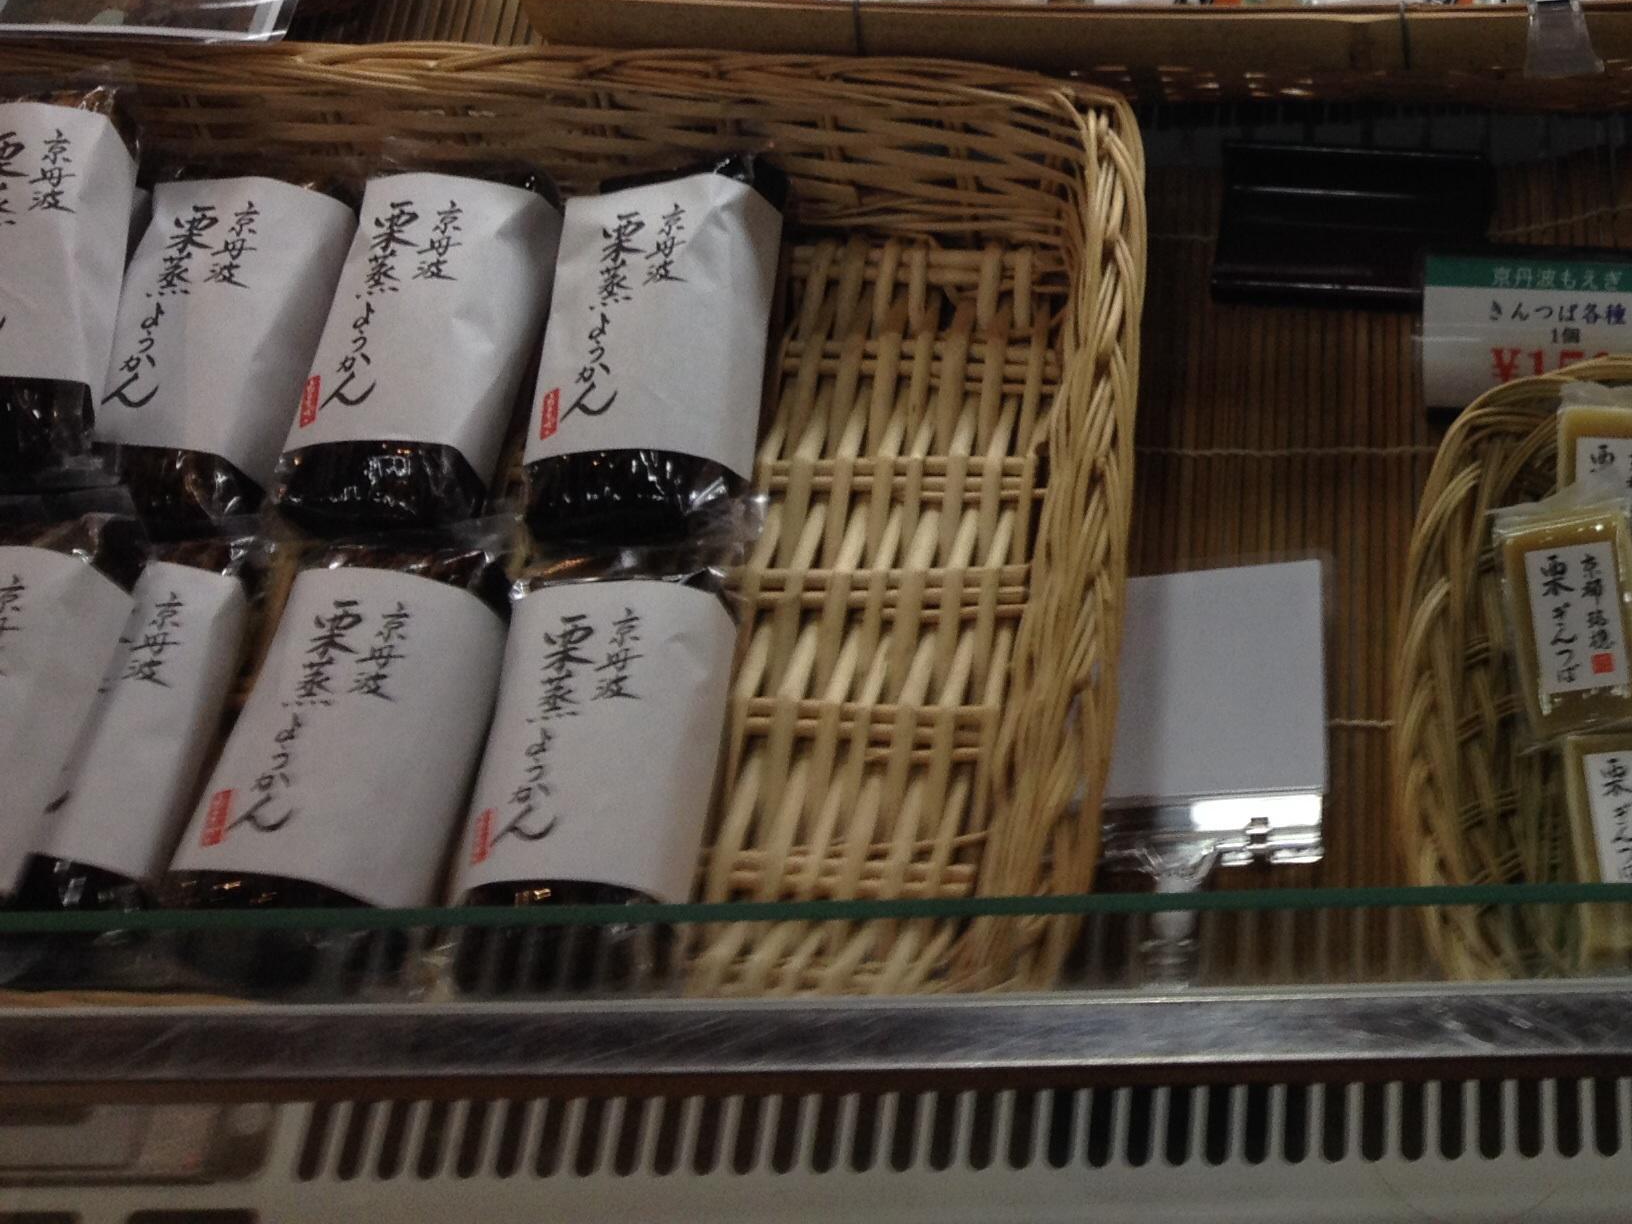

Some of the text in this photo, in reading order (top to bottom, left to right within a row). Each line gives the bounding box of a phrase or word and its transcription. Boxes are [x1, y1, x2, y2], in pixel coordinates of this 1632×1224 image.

[28, 128, 76, 214] 京丹波
[203, 200, 259, 290] 京丹波
[411, 199, 464, 282] 京丹波
[642, 202, 689, 287] 京丹波
[1491, 266, 1622, 292] 京丹波もえぎ
[319, 200, 419, 407] 栗蒸ようかん
[560, 210, 646, 422] 栗蒸ようかん
[1488, 299, 1628, 326] きんつば各種
[120, 591, 184, 689] 京丹波
[349, 601, 414, 703] 京丹波
[591, 607, 644, 703] 京丹波
